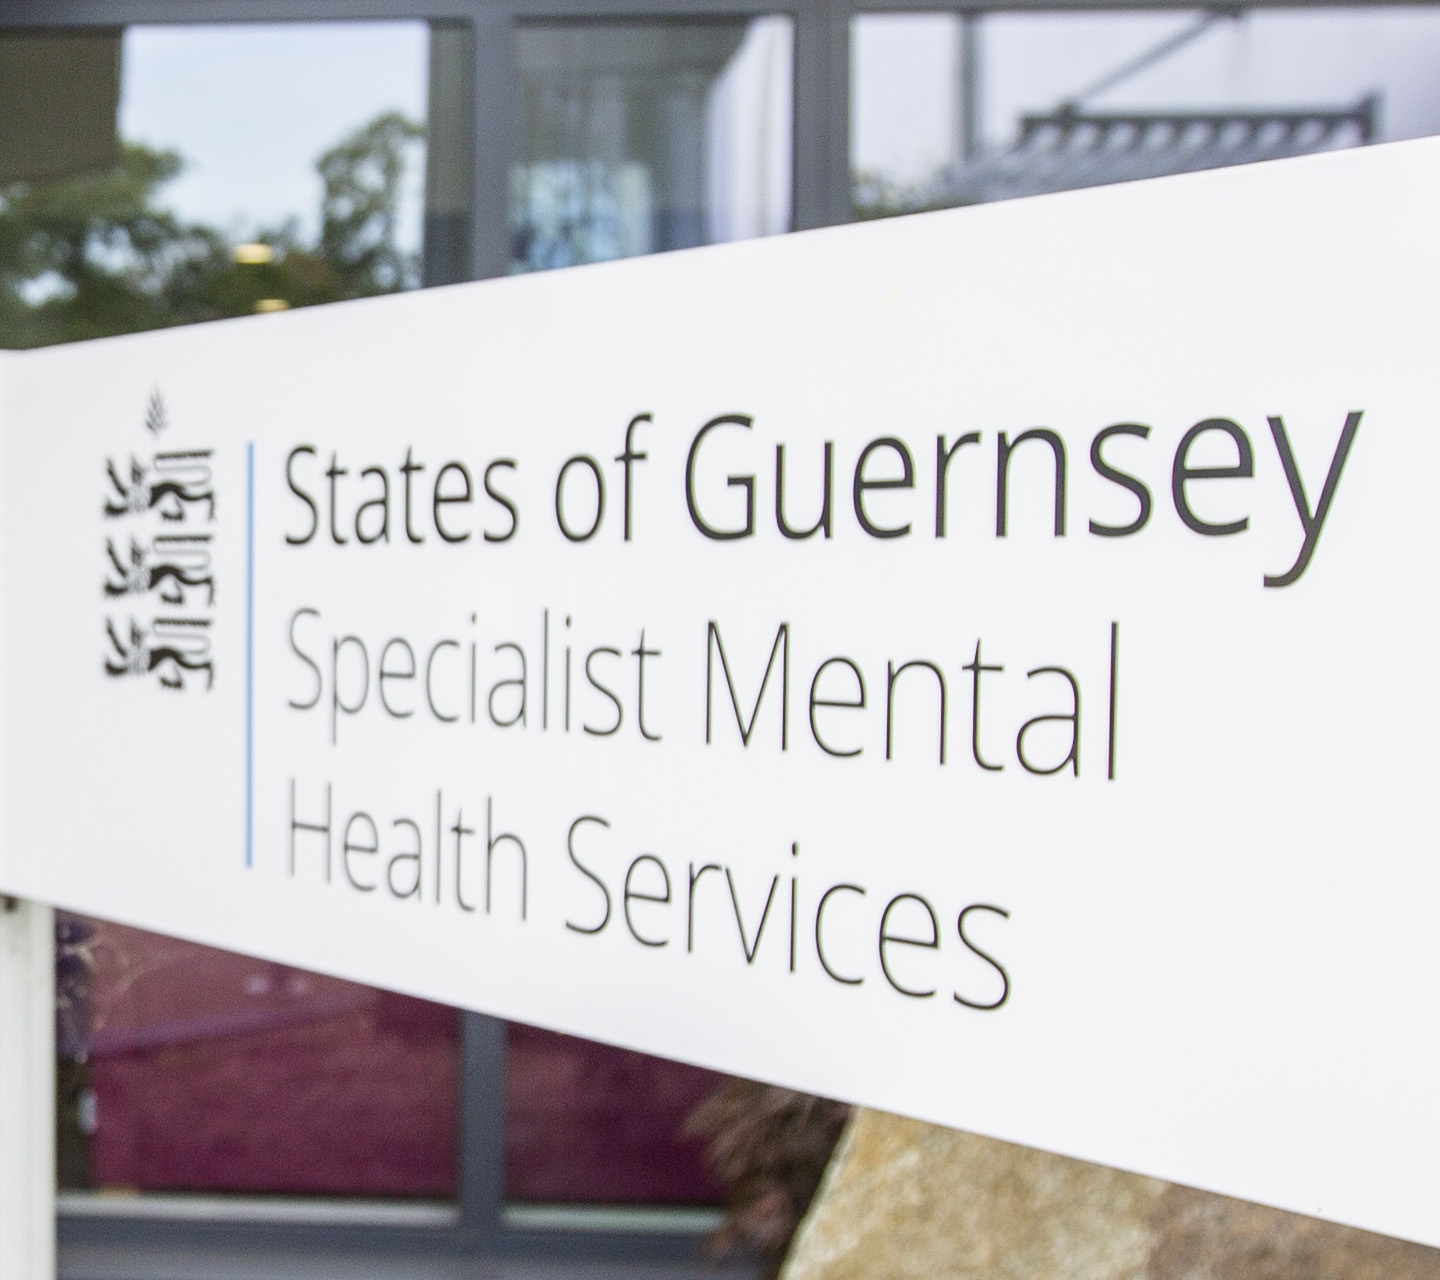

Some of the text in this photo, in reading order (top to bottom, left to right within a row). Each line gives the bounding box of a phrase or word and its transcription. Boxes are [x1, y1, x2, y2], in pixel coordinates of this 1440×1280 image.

[282, 408, 1366, 591] States of Guernsey
[286, 605, 1120, 783] Specialist Mental
[288, 777, 1013, 1014] Health Services
